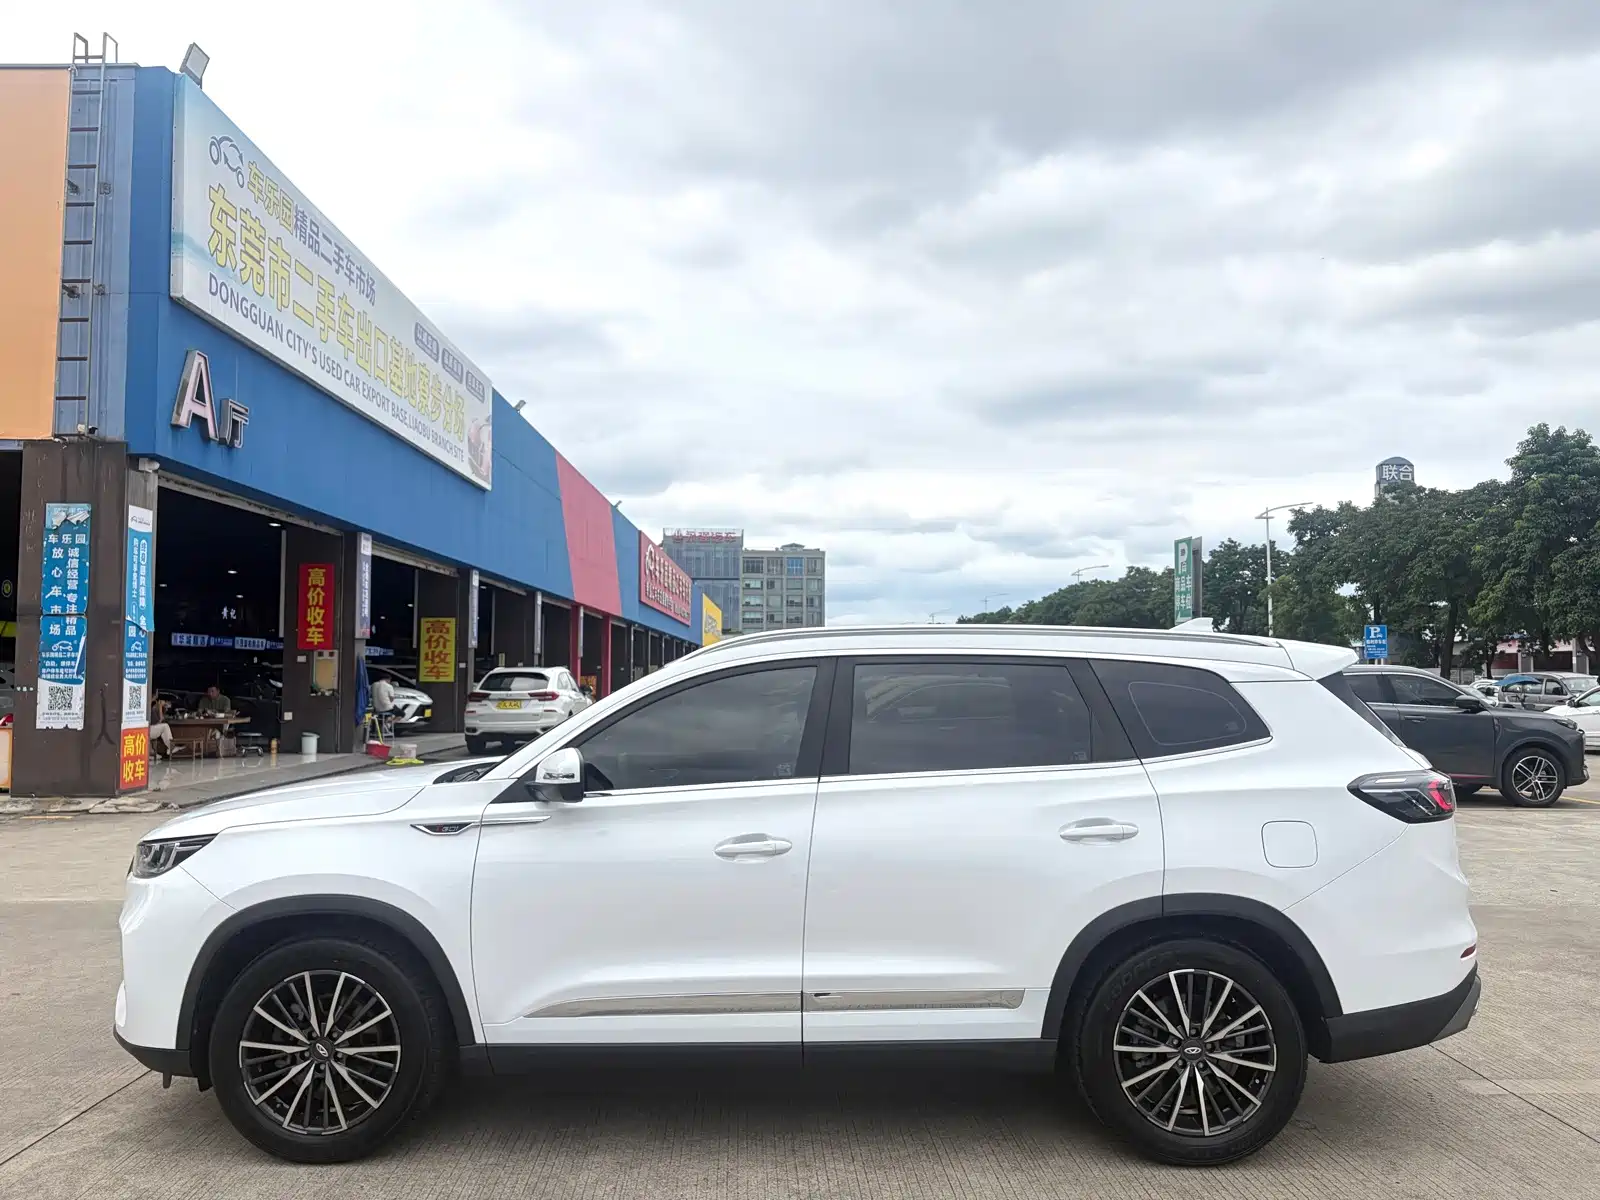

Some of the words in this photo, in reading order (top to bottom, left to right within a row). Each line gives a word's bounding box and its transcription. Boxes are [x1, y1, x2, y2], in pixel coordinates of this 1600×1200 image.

[248, 161, 376, 306] 车乐园精品二手车市场
[209, 272, 284, 343] DONGGUAN
[286, 329, 318, 365] CITY'S
[319, 351, 343, 381] USED
[343, 369, 361, 394] CAR
[362, 381, 390, 412] EXPORT
[431, 429, 454, 458] BRANCH
[453, 445, 465, 462] SITE
[1382, 464, 1413, 481] 联合
[48, 533, 86, 544] 车乐园
[306, 568, 326, 646] 高价收车
[1369, 626, 1380, 638] P
[424, 619, 451, 680] 高价收车
[123, 734, 147, 758] 高价
[122, 758, 146, 783] 收车
